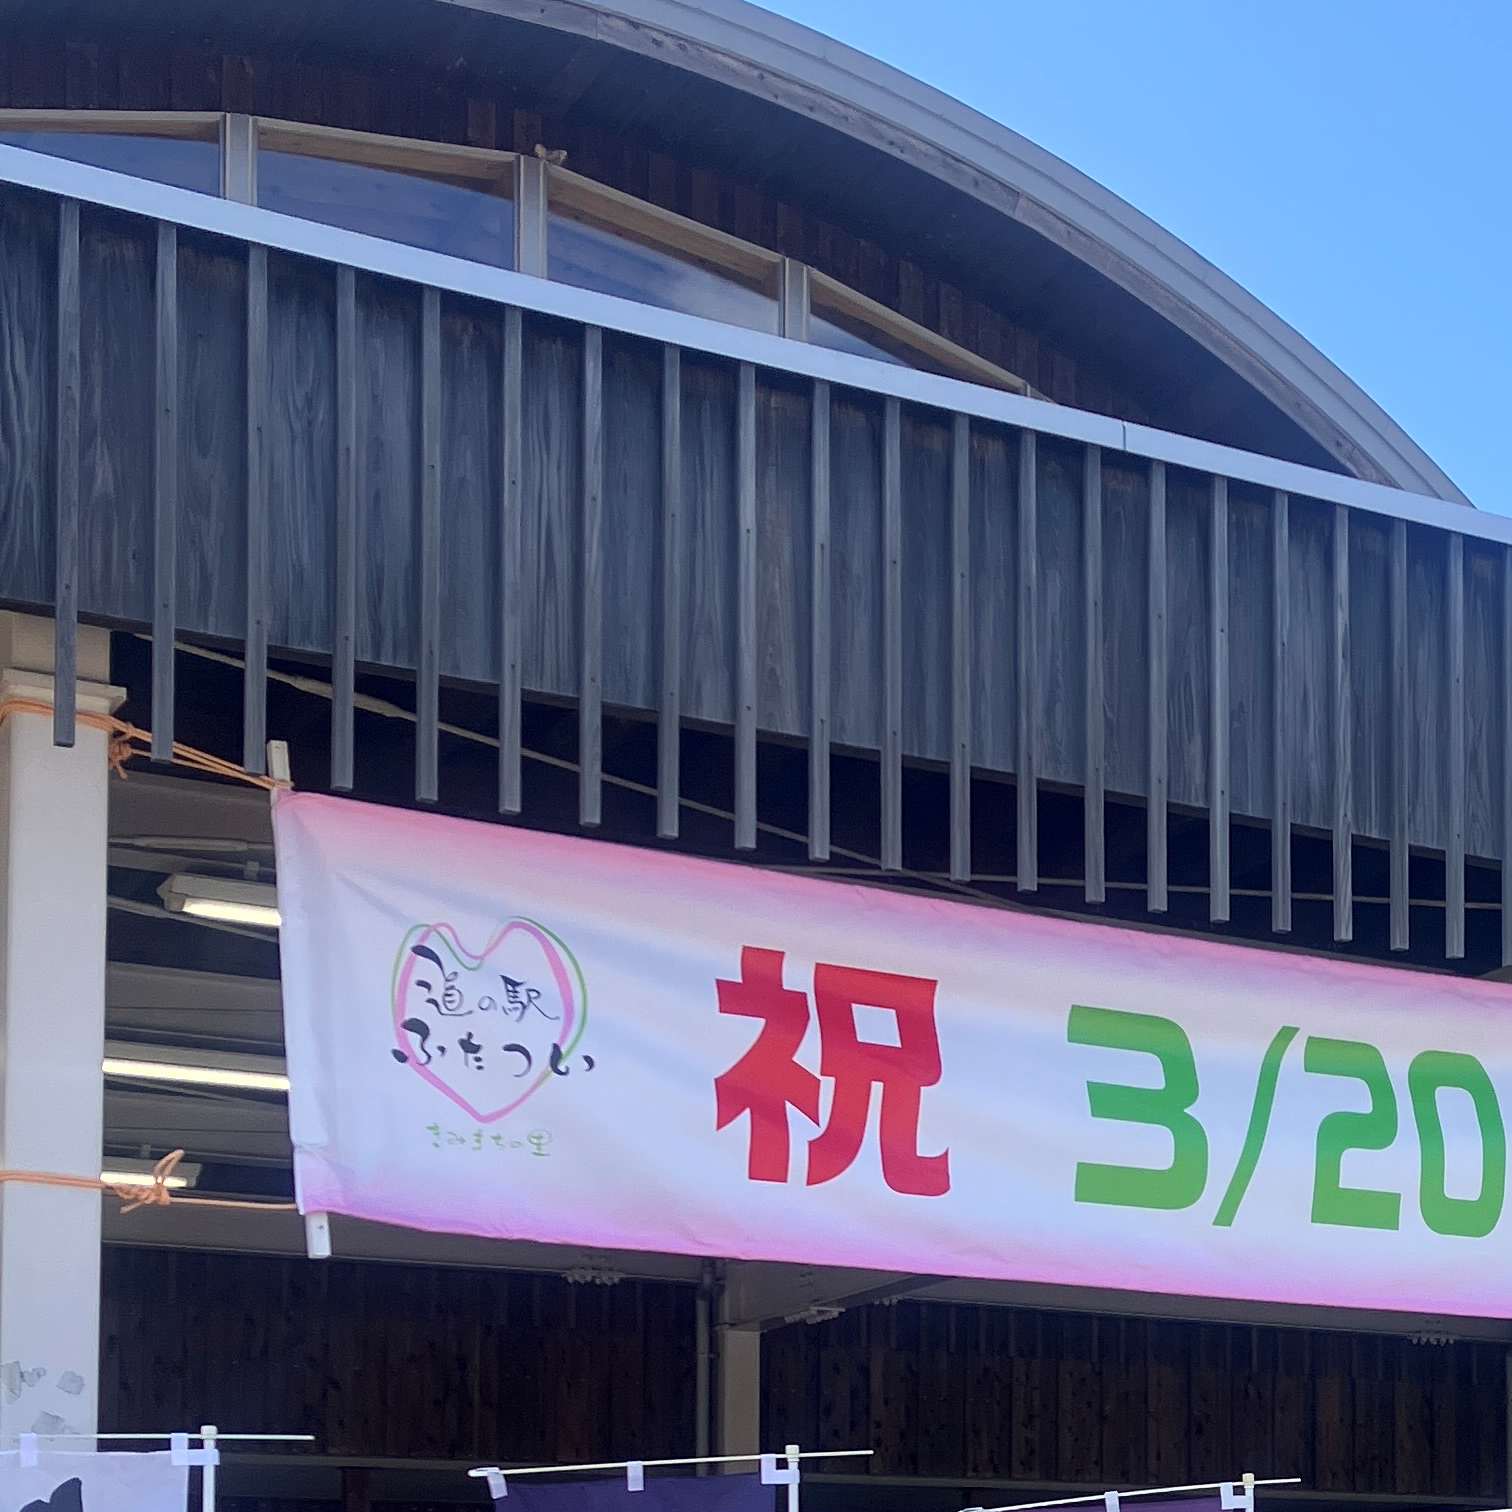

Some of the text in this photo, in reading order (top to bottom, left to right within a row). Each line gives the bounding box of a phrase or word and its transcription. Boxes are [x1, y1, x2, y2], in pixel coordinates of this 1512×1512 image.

[411, 945, 560, 1022] 道の駅
[715, 945, 952, 1198] 祝
